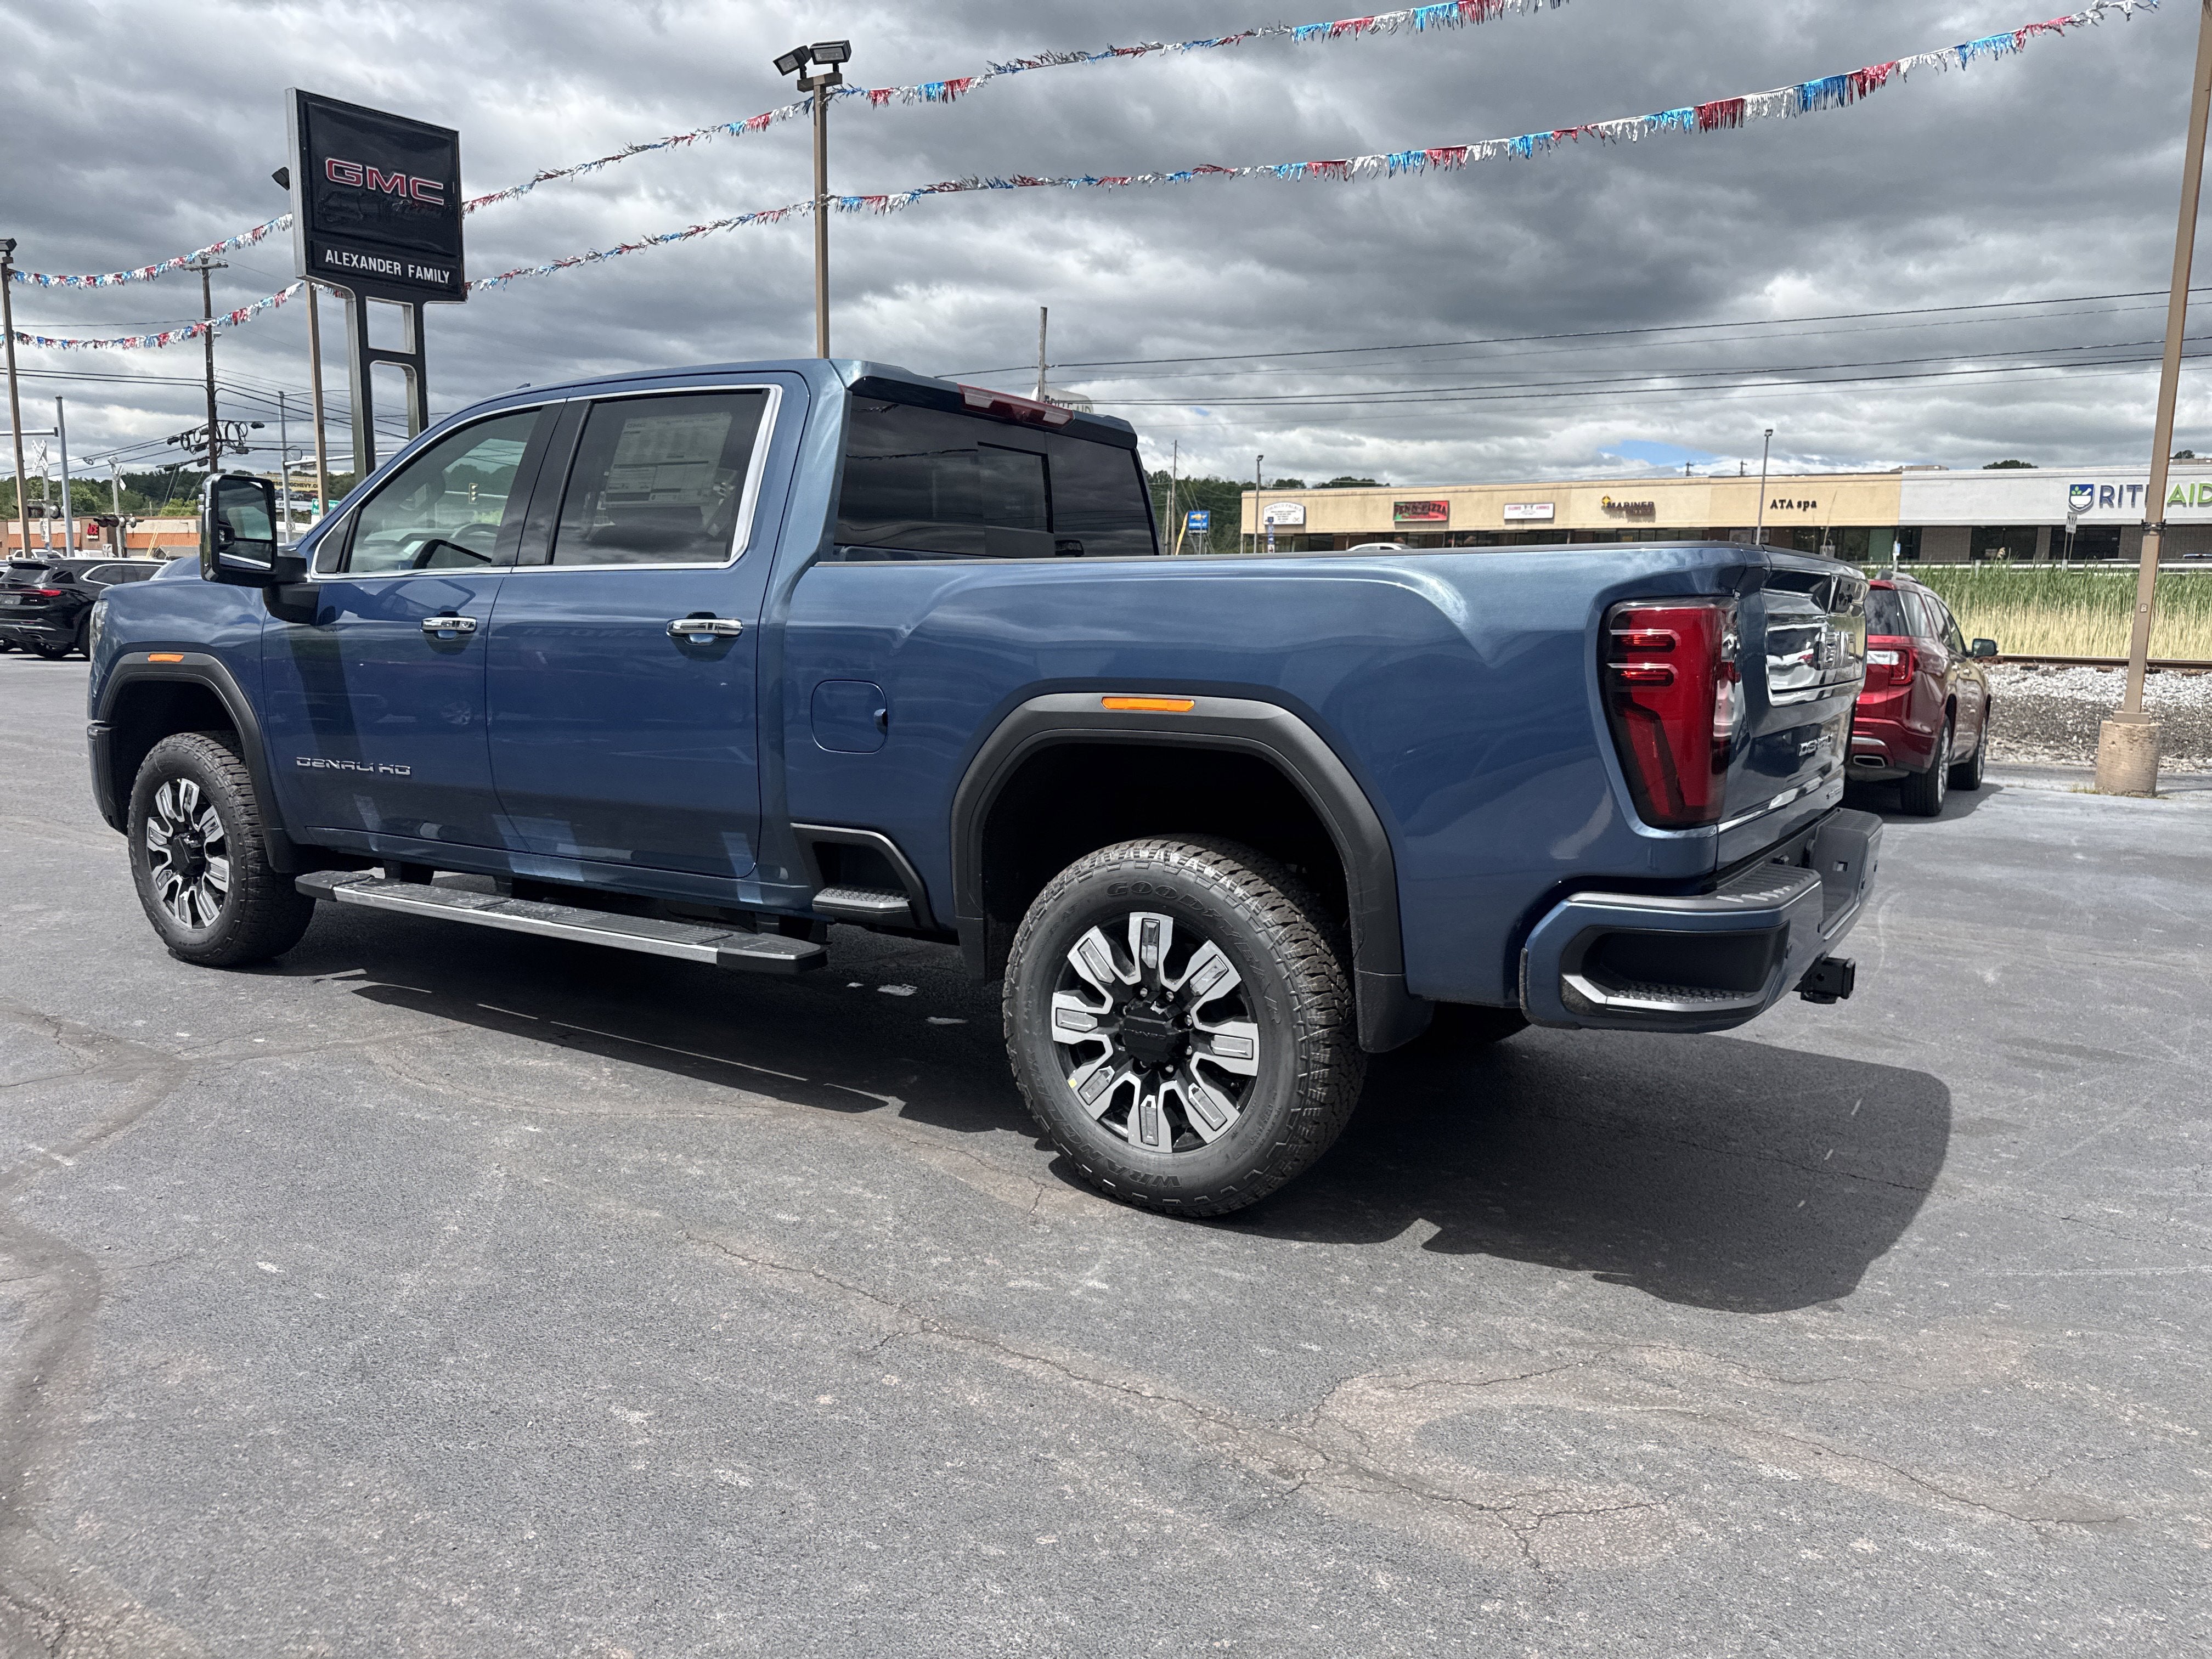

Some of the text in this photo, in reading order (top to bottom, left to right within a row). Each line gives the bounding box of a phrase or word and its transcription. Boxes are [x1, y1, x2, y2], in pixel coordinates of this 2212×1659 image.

[325, 157, 444, 206] GMC
[325, 249, 450, 284] ALEXANDER FAMILY
[1770, 499, 1816, 512] ATA spa
[296, 757, 411, 776] DENALI HD
